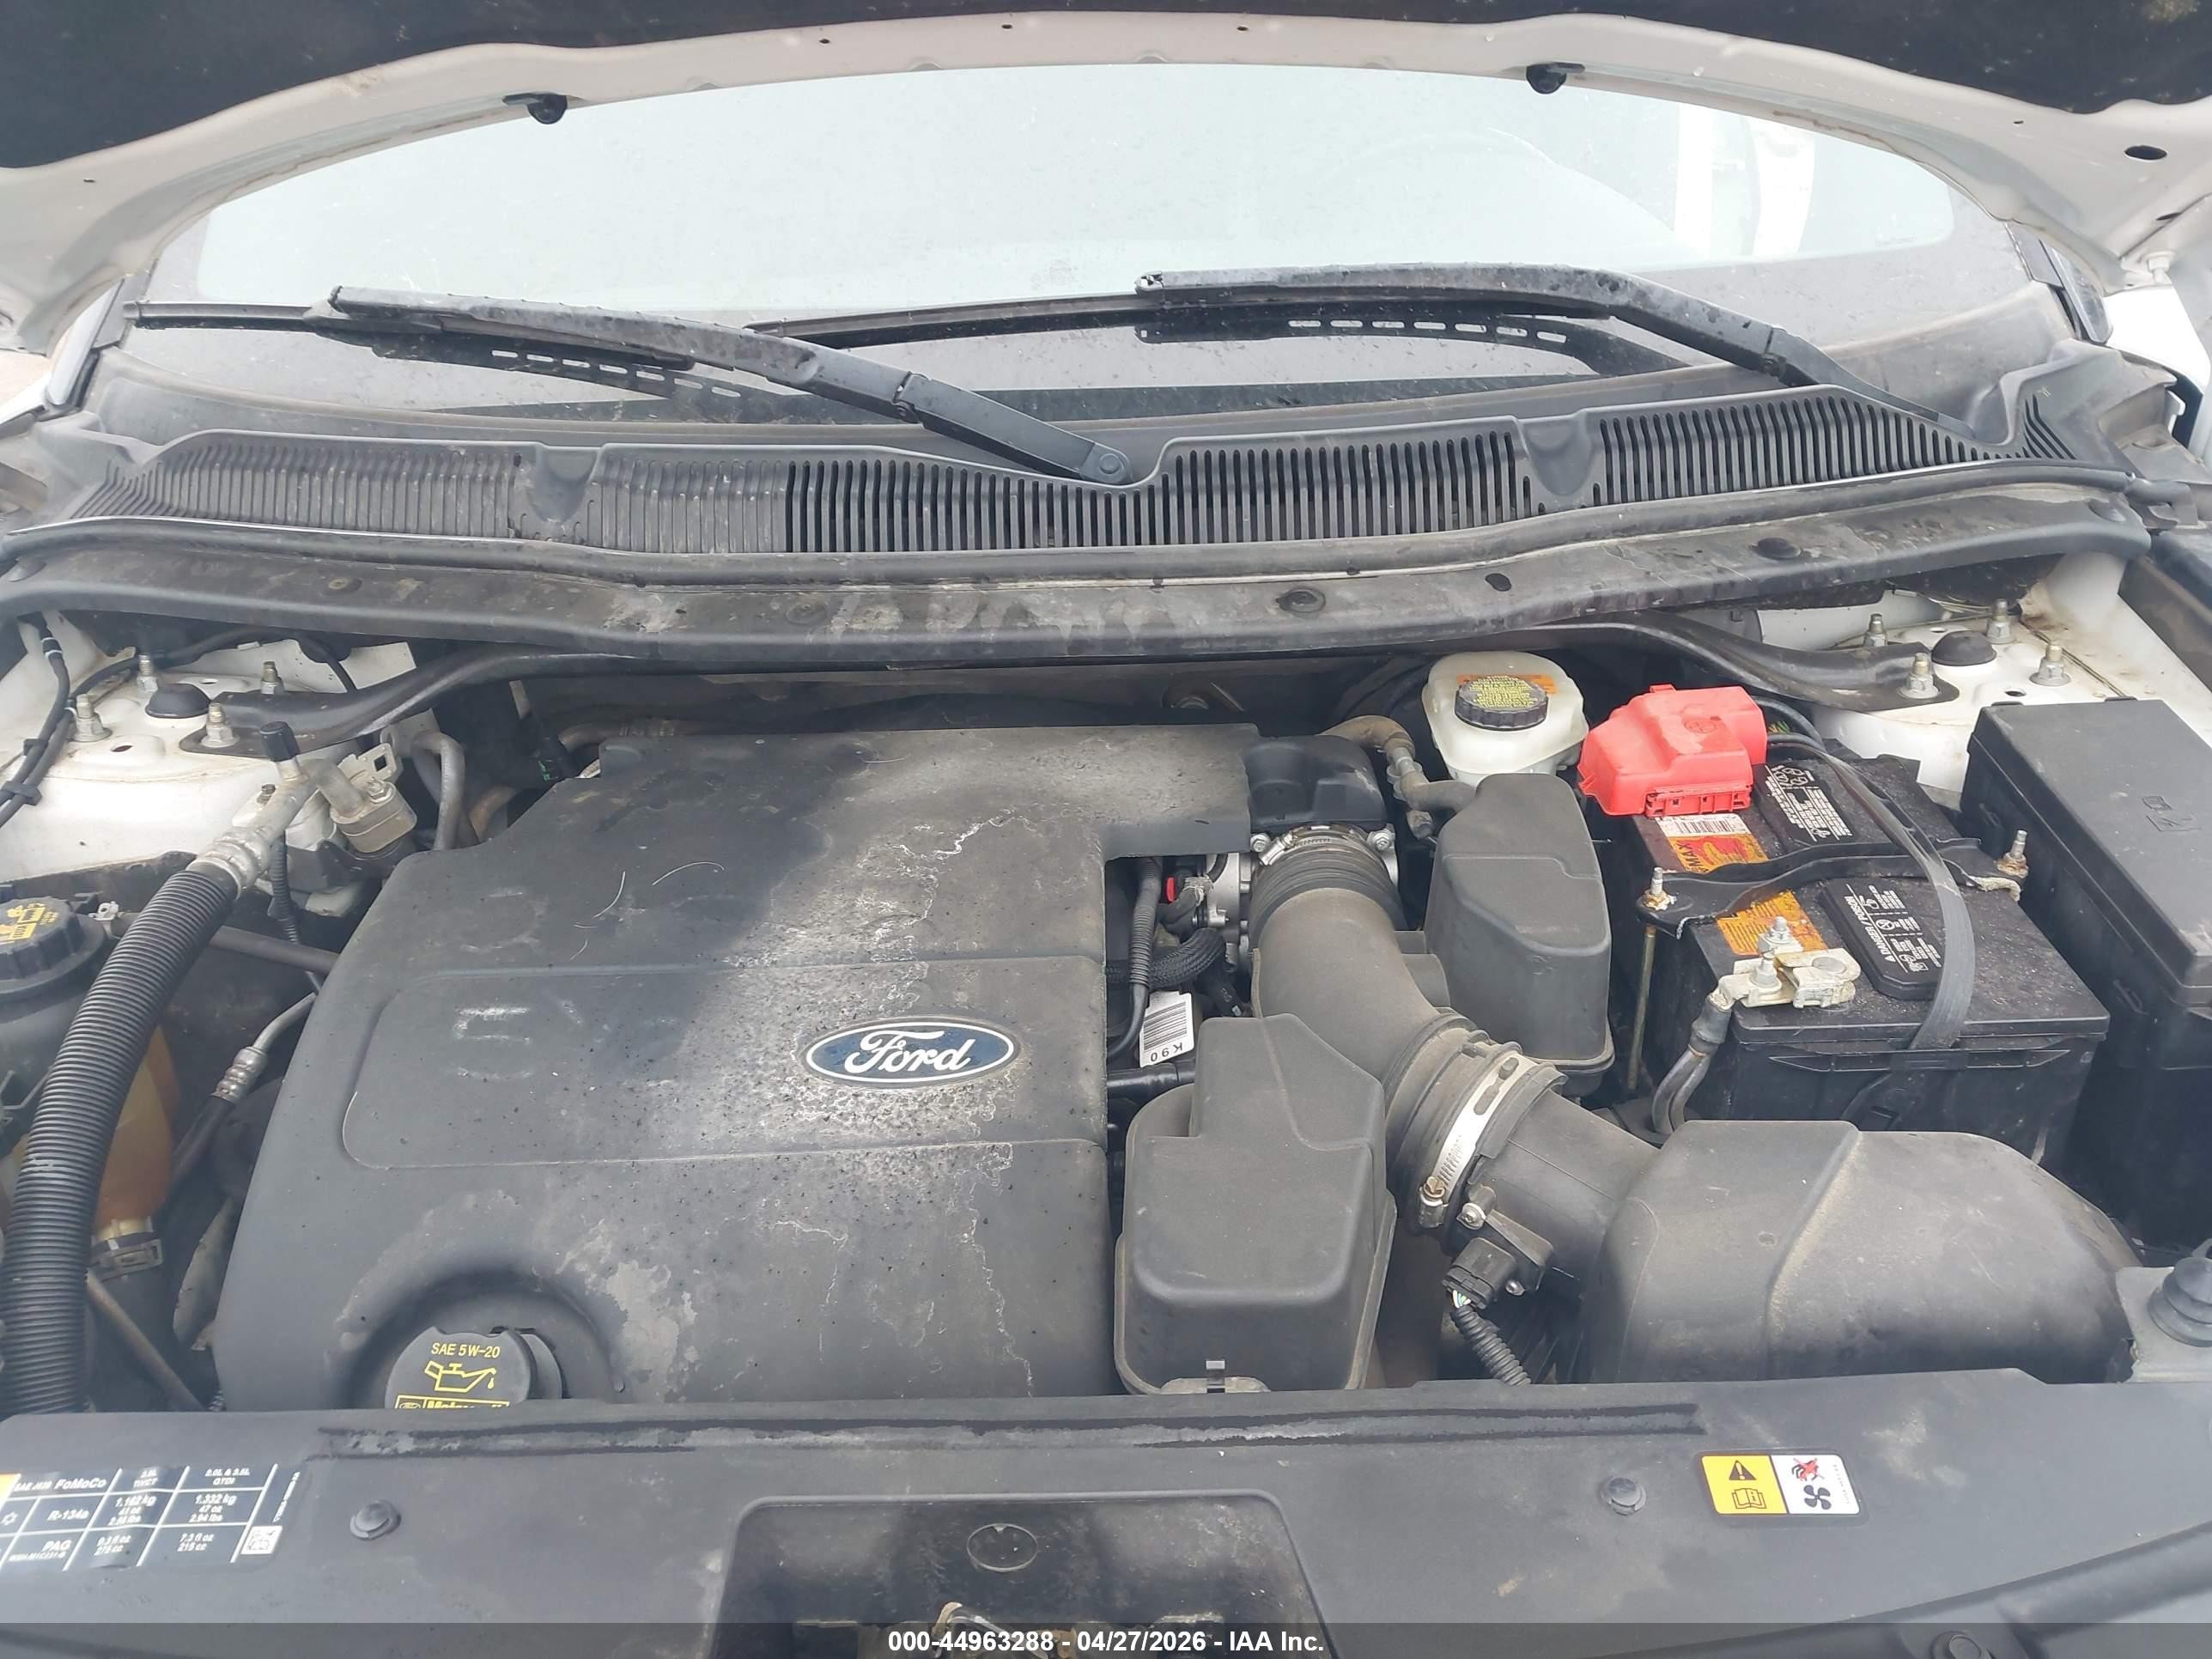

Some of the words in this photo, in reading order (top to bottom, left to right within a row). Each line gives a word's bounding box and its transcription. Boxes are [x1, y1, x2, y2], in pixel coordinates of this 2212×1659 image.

[1844, 896, 1869, 921] POISON
[1865, 927, 1892, 955] DANGER
[844, 1030, 976, 1073] Ford
[1150, 1042, 1183, 1062] K90
[431, 1342, 456, 1357] SAE
[458, 1344, 501, 1358] 5W-20
[54, 1476, 107, 1491] FoMoCo
[222, 1493, 238, 1506] kg
[47, 1509, 89, 1522] R-134a
[41, 1540, 72, 1552] PAG
